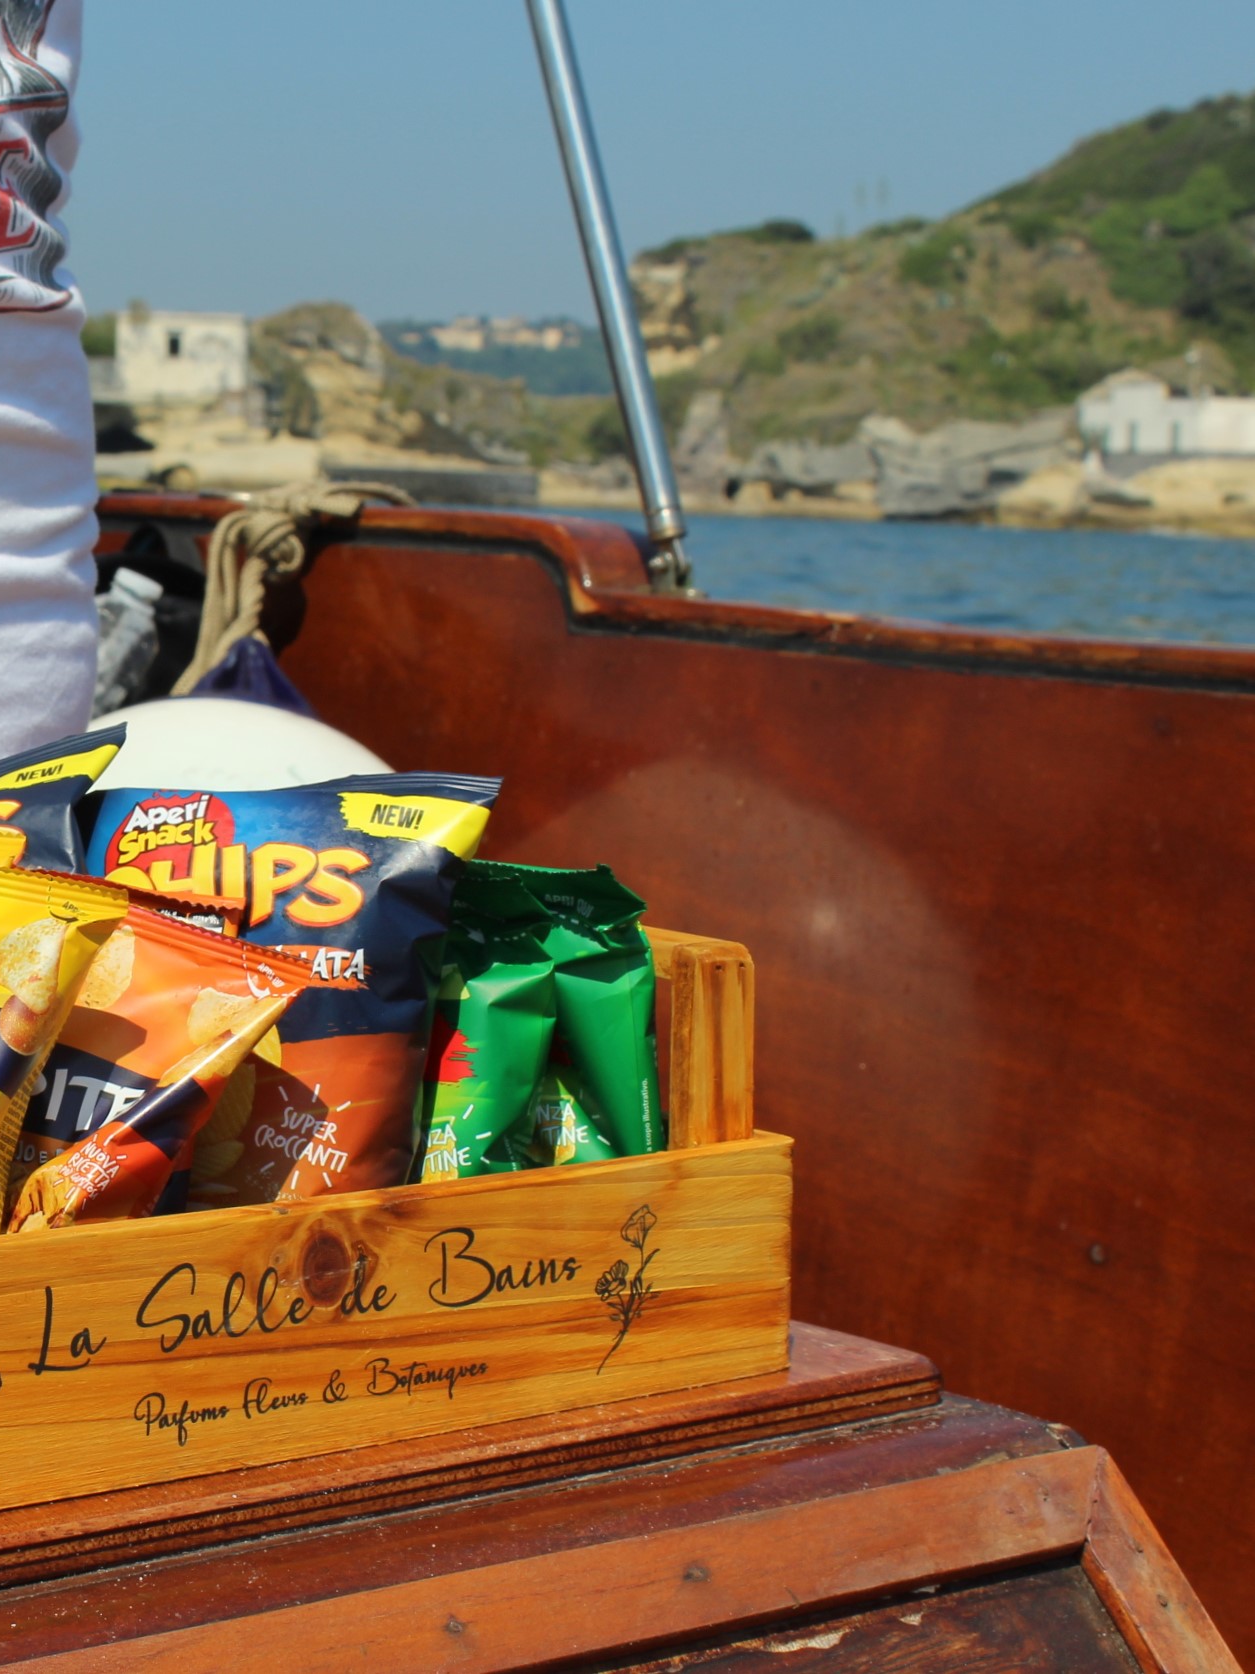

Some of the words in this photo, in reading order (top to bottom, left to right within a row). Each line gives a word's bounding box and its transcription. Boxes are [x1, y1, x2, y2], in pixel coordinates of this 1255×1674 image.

[15, 764, 64, 784] NEW!
[123, 793, 212, 833] Aperi
[370, 803, 424, 830] NEW!
[117, 817, 216, 865] Snack
[543, 893, 575, 906] APRI
[256, 962, 276, 981] APRI
[281, 1106, 337, 1145] SUPER
[79, 1141, 120, 1179] NUOVA
[254, 1124, 349, 1173] CROCCANTI
[68, 1152, 111, 1192] RICETTA
[28, 1285, 107, 1375] La
[135, 1262, 315, 1353] Salle
[341, 1252, 397, 1315] de
[424, 1226, 582, 1308] Bains
[322, 1368, 349, 1404] &
[364, 1357, 489, 1400] Botaniques
